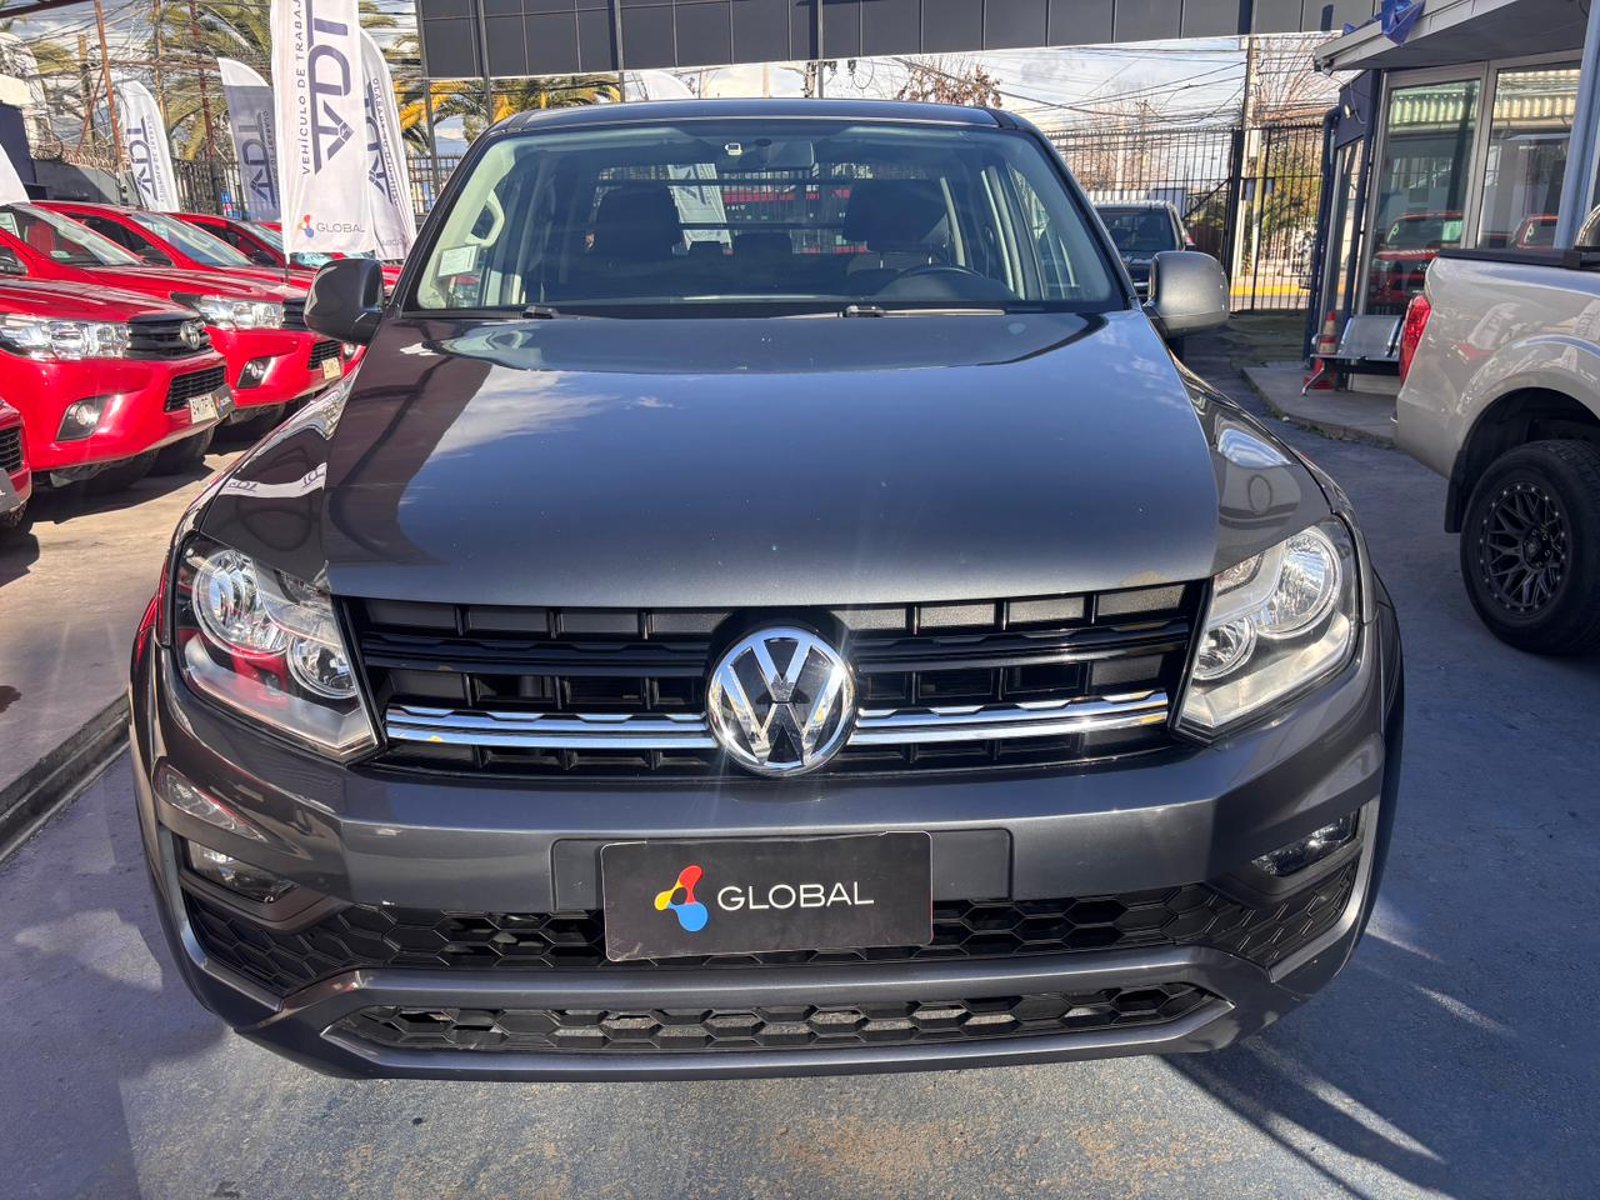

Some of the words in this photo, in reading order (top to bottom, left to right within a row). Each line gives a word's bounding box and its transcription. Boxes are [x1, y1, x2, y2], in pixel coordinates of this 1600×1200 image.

[293, 0, 305, 61] TRABAJ
[296, 68, 306, 89] DE
[297, 95, 311, 176] VEHÍCULO
[316, 222, 366, 233] GLOBAL
[717, 881, 875, 911] GLOBAL
